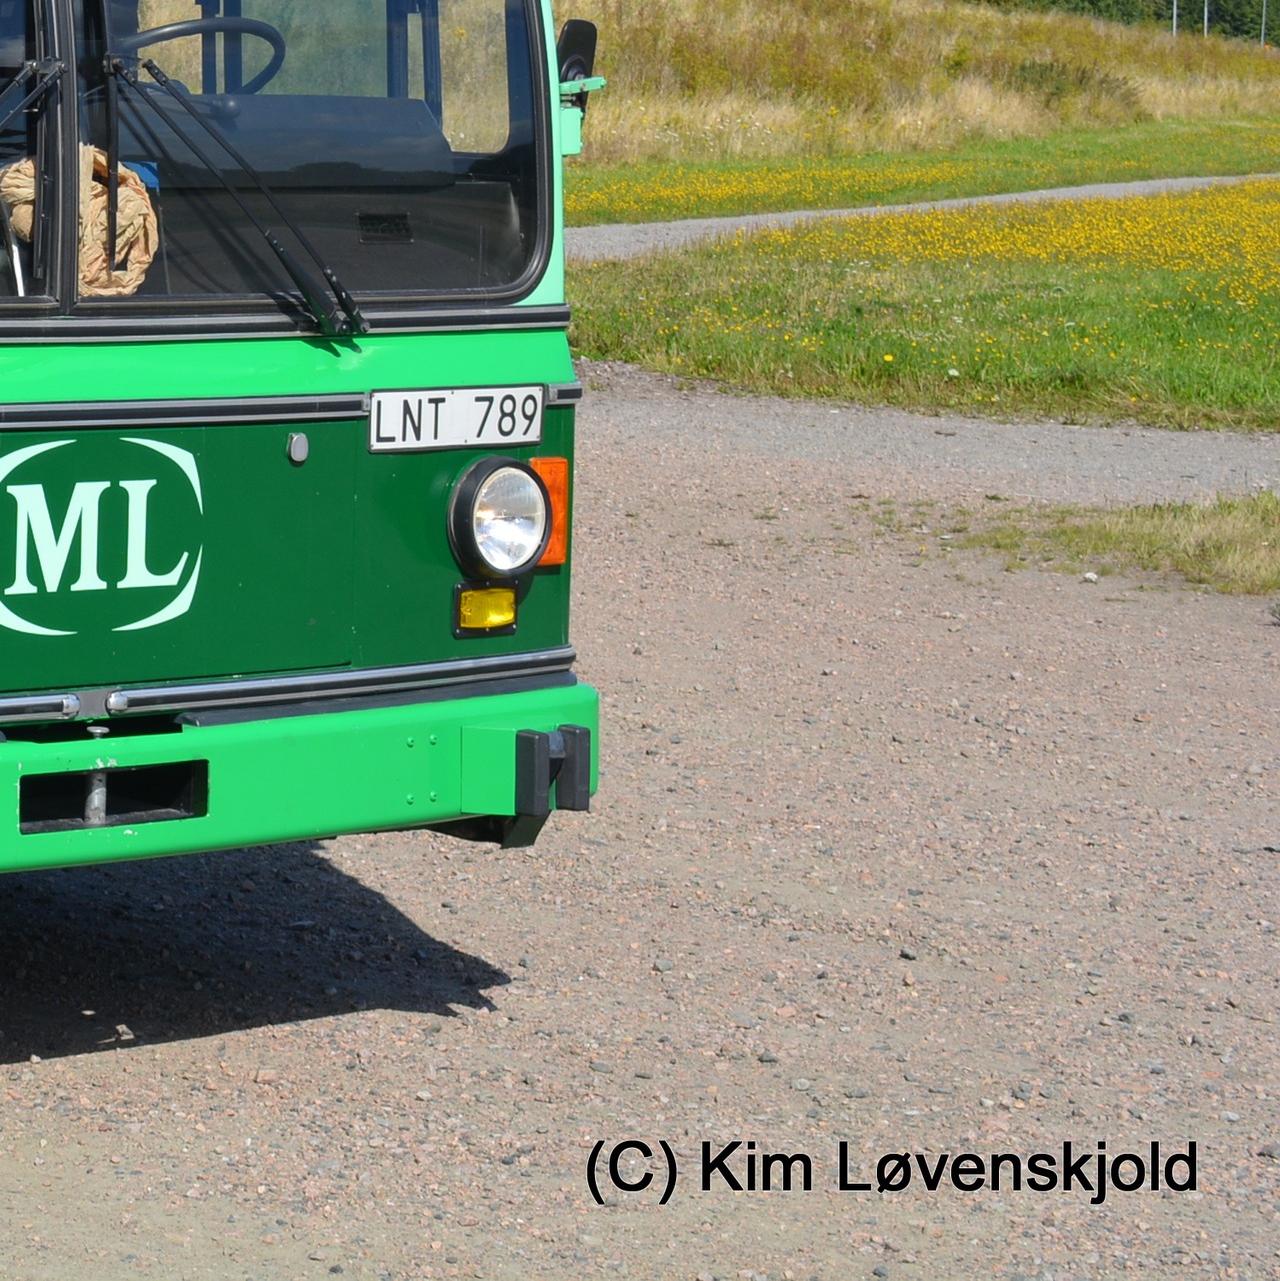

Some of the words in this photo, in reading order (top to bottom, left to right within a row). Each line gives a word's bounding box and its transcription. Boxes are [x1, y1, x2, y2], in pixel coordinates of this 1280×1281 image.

[375, 397, 446, 442] LNT
[474, 394, 538, 438] 789
[4, 479, 189, 595] ML
